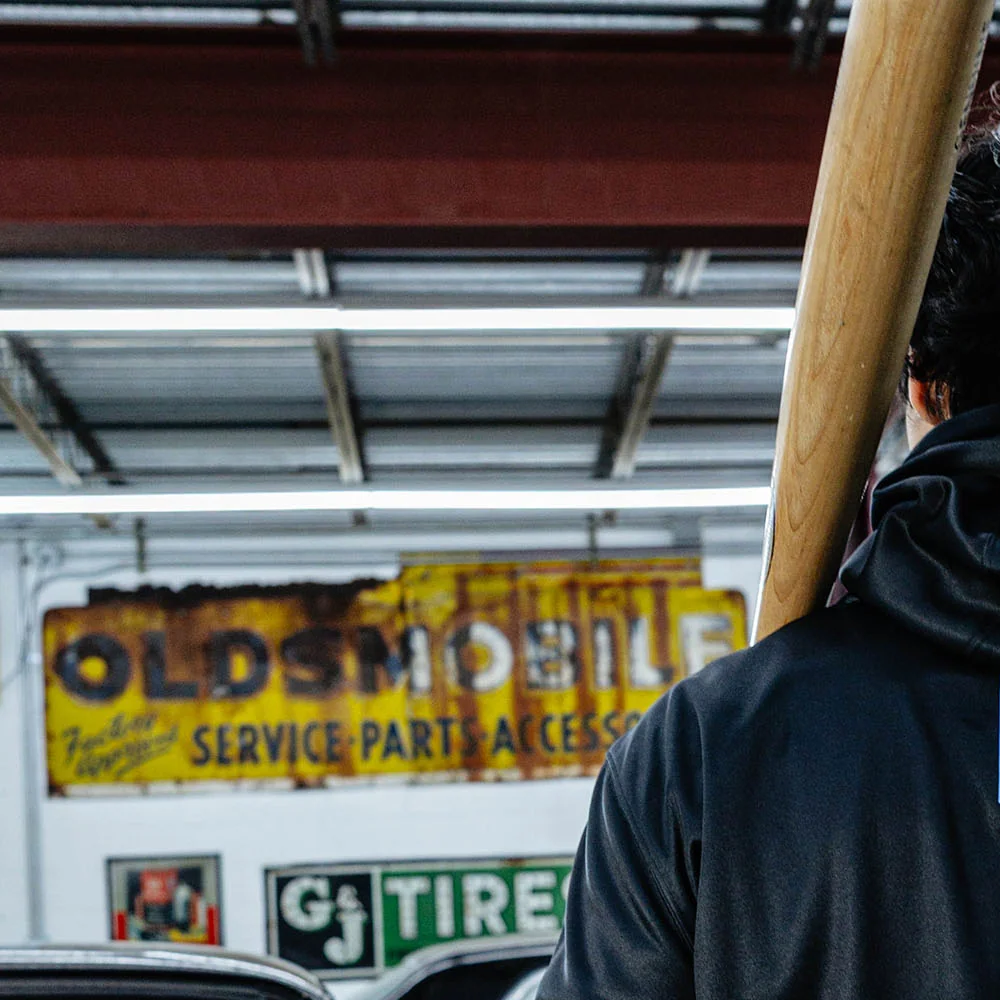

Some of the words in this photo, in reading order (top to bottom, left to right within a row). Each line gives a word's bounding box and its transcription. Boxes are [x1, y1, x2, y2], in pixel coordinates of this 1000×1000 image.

[192, 719, 341, 767] SERVICE
[361, 714, 479, 760] PARTS
[384, 870, 570, 940] TIRE
